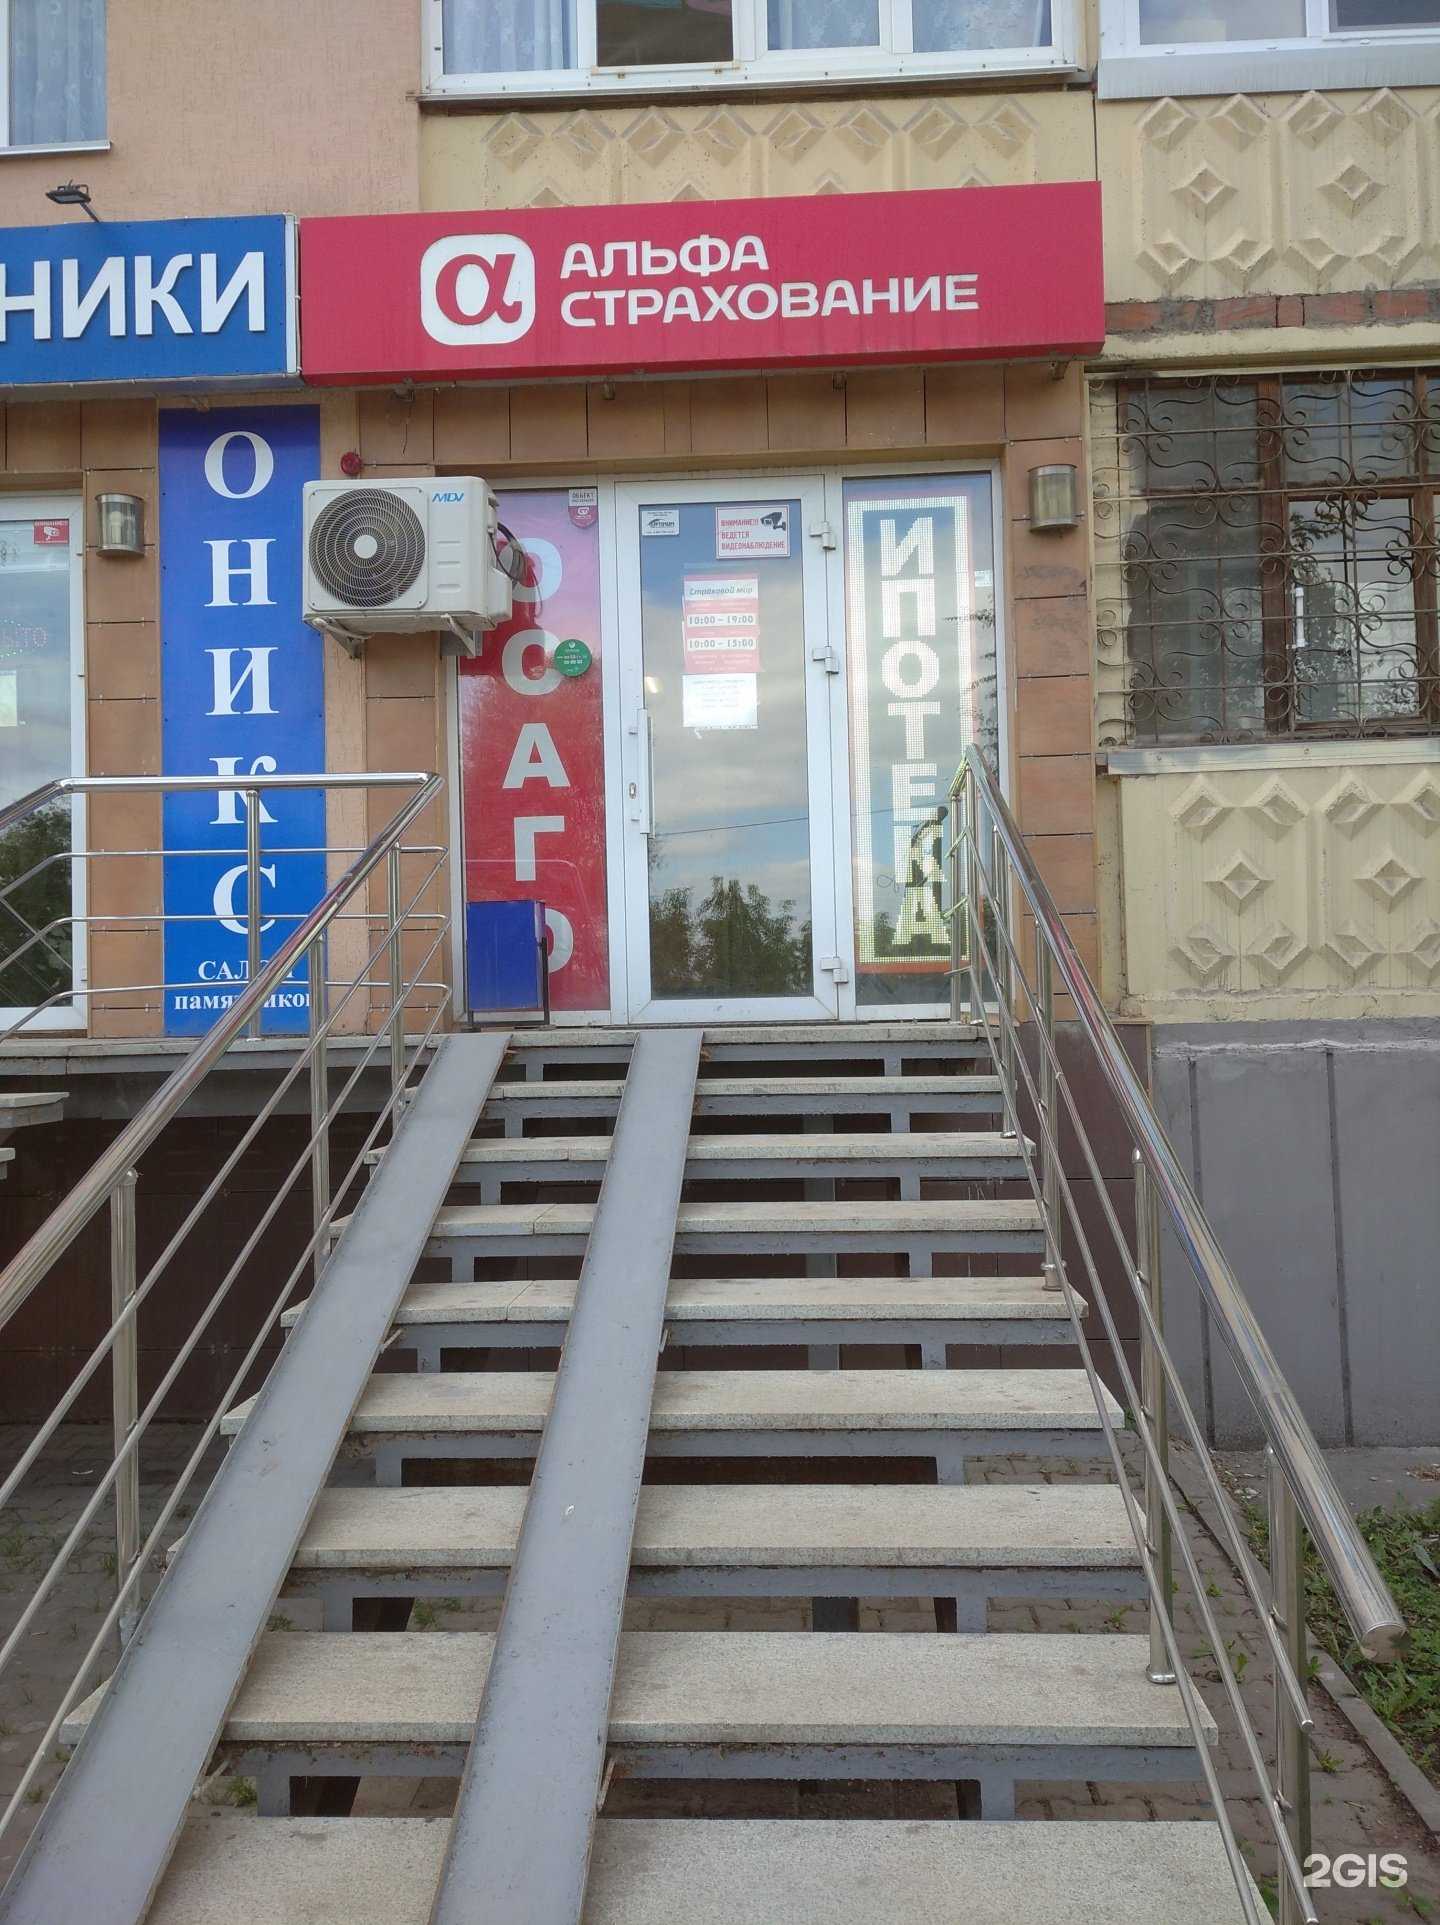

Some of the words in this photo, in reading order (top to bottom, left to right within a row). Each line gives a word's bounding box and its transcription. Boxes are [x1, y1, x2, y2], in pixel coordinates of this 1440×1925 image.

[559, 234, 769, 279] АЛЬФА
[561, 273, 979, 327] СТРАХОВАНИЕ
[432, 492, 465, 502] MDV
[721, 541, 785, 550] ВИДЕОНАБЛЮДЕНИЕ
[689, 586, 735, 596] Страховой
[689, 616, 716, 624] 10:00
[727, 615, 754, 623] 19:00
[689, 640, 716, 648] 10:00
[727, 639, 754, 647] 15:00
[203, 430, 279, 935] ОНИКС
[880, 516, 952, 945] ИПОТЕКА
